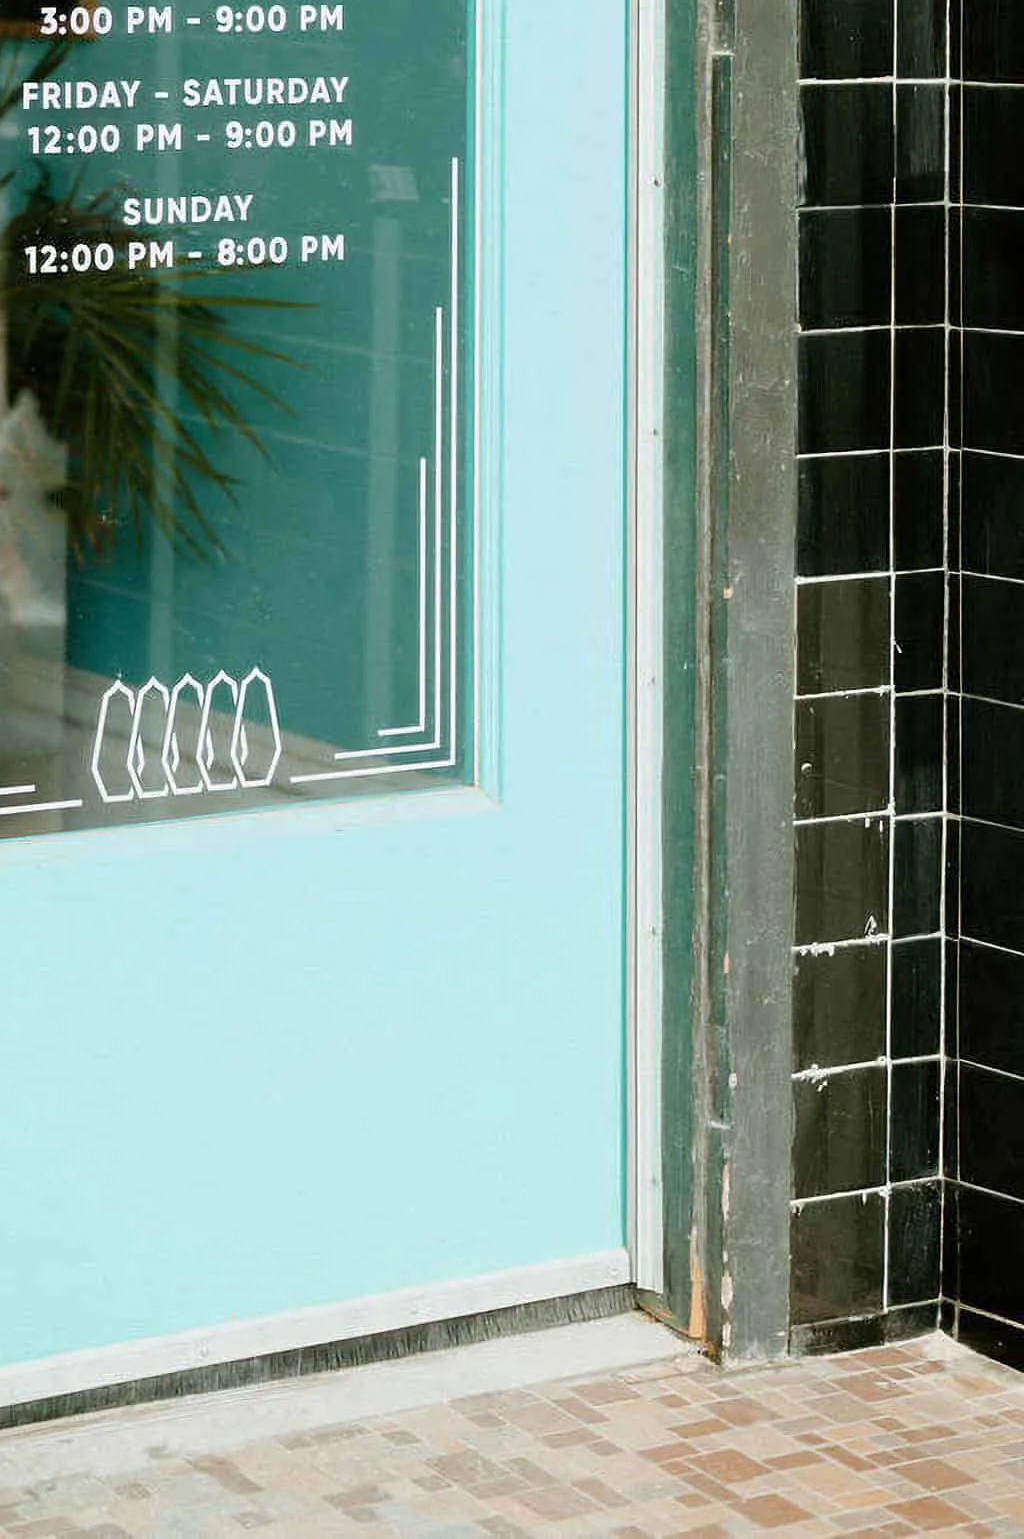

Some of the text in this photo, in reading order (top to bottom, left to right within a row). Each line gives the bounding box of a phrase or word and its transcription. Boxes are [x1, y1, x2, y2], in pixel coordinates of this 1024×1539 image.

[40, 6, 113, 35] 3:00
[127, 6, 172, 34] PM
[215, 4, 287, 33] 9:00
[300, 4, 343, 31] PM
[22, 80, 141, 110] FRIDAY
[183, 76, 349, 107] SATURDAY
[27, 124, 120, 154] 12:00
[136, 123, 182, 151] PM
[225, 120, 296, 149] 9:00
[309, 119, 353, 146] PM
[123, 194, 254, 226] SUNDAY
[24, 243, 114, 274] 12:00
[128, 240, 173, 270] PM
[217, 236, 288, 266] 8:00
[301, 234, 345, 262] PM
